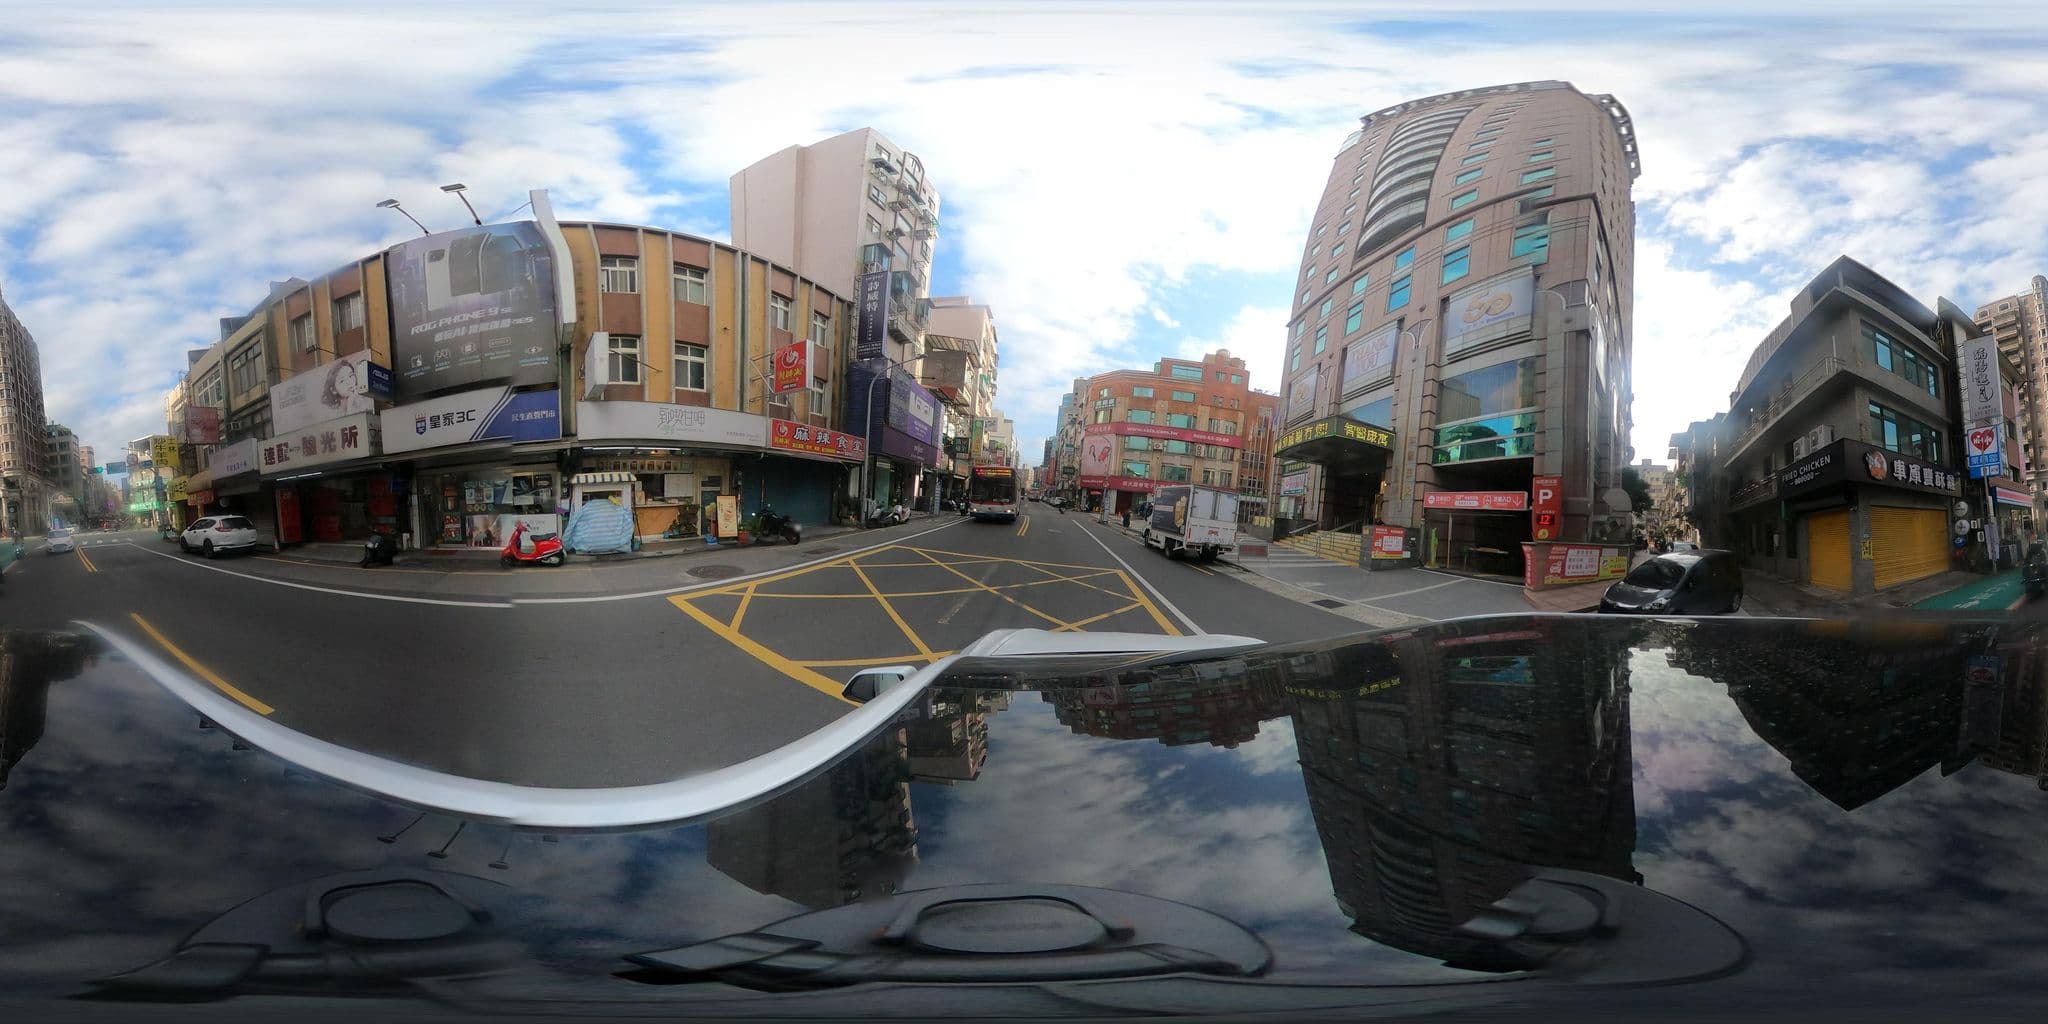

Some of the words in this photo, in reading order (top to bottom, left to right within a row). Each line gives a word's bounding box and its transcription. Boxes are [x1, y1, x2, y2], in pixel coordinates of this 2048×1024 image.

[438, 308, 486, 327] PHONE
[429, 409, 476, 430] 皇家3C
[793, 427, 863, 453] 麻辣食堂
[1799, 454, 1831, 476] CHICKEN
[1538, 489, 1553, 505] P
